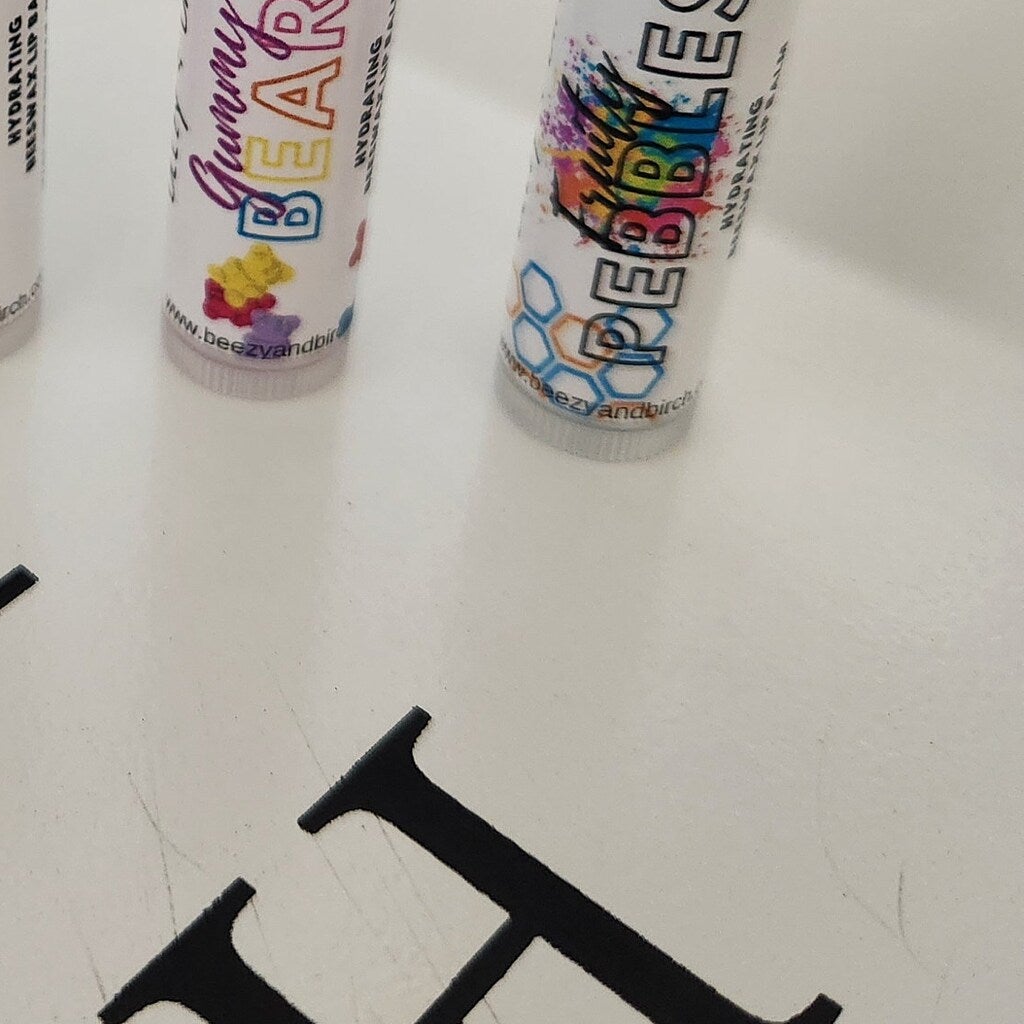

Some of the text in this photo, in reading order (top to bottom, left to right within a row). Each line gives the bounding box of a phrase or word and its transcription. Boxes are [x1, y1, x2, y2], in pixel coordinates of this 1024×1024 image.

[7, 15, 23, 147] HYDRATING
[354, 35, 383, 169] HYDRATING
[719, 95, 765, 232] HYDRATING
